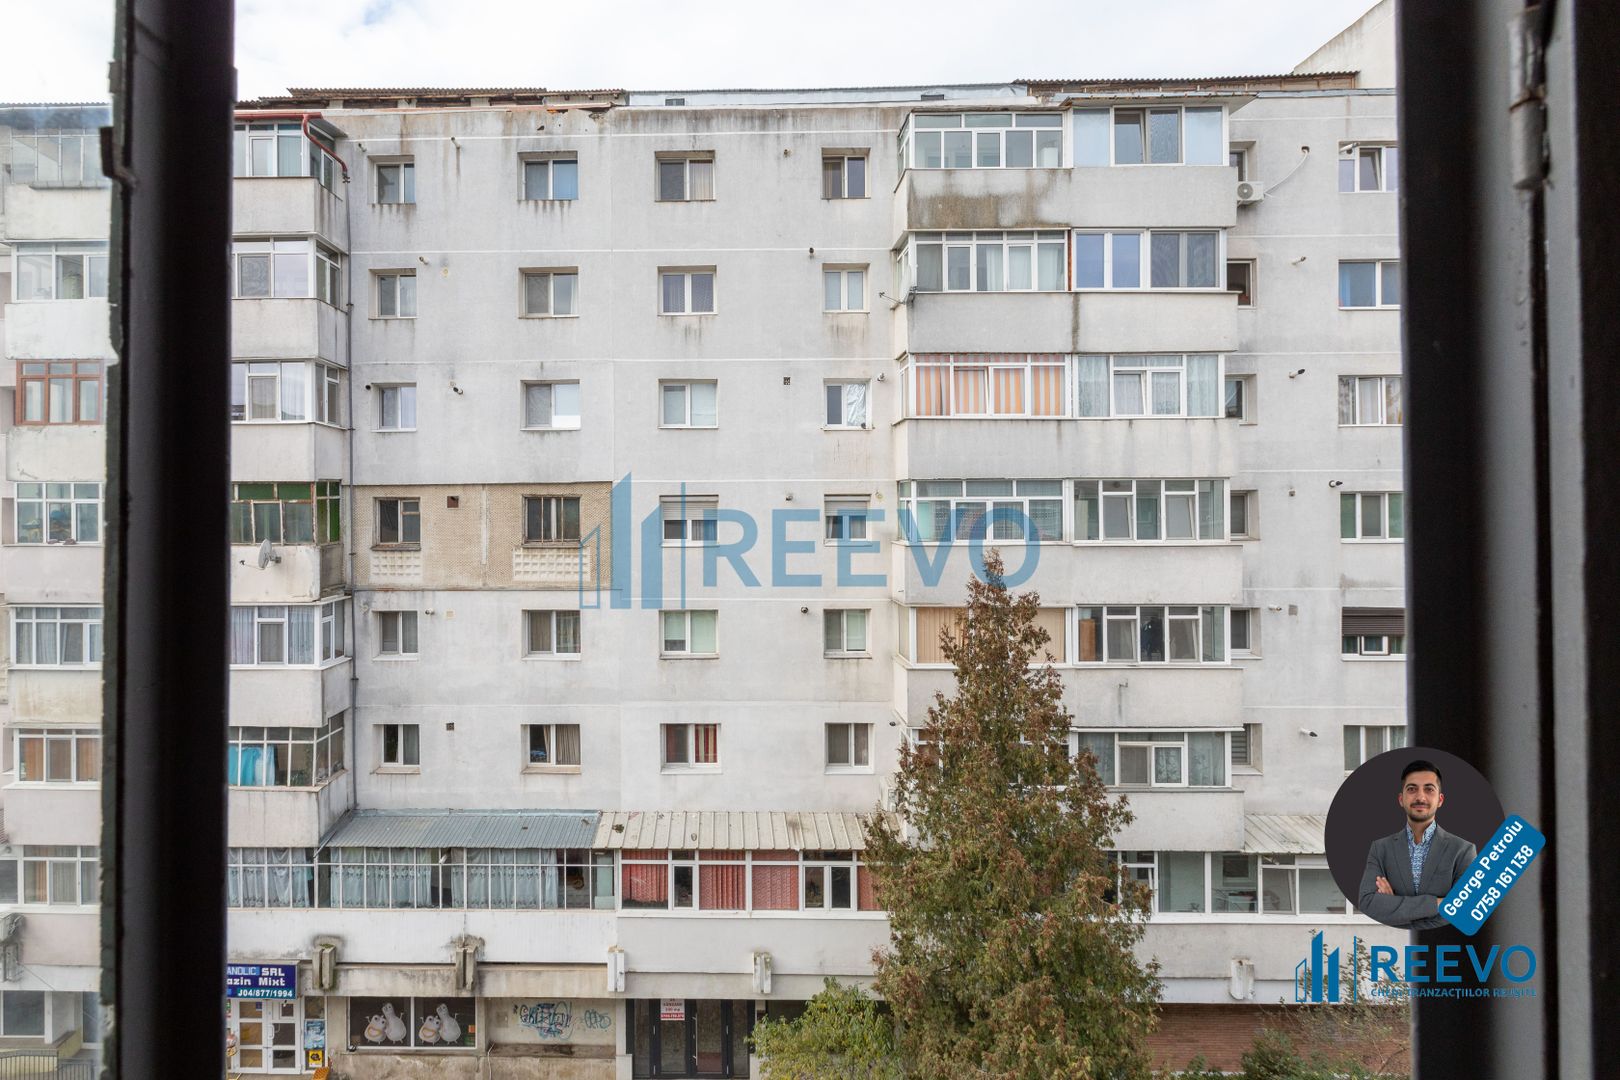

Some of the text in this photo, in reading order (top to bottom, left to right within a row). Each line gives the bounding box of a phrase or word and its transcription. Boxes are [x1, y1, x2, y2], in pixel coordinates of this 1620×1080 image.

[261, 967, 285, 976] SRL
[258, 977, 286, 986] Mixt
[237, 989, 293, 997] J04/877/1994
